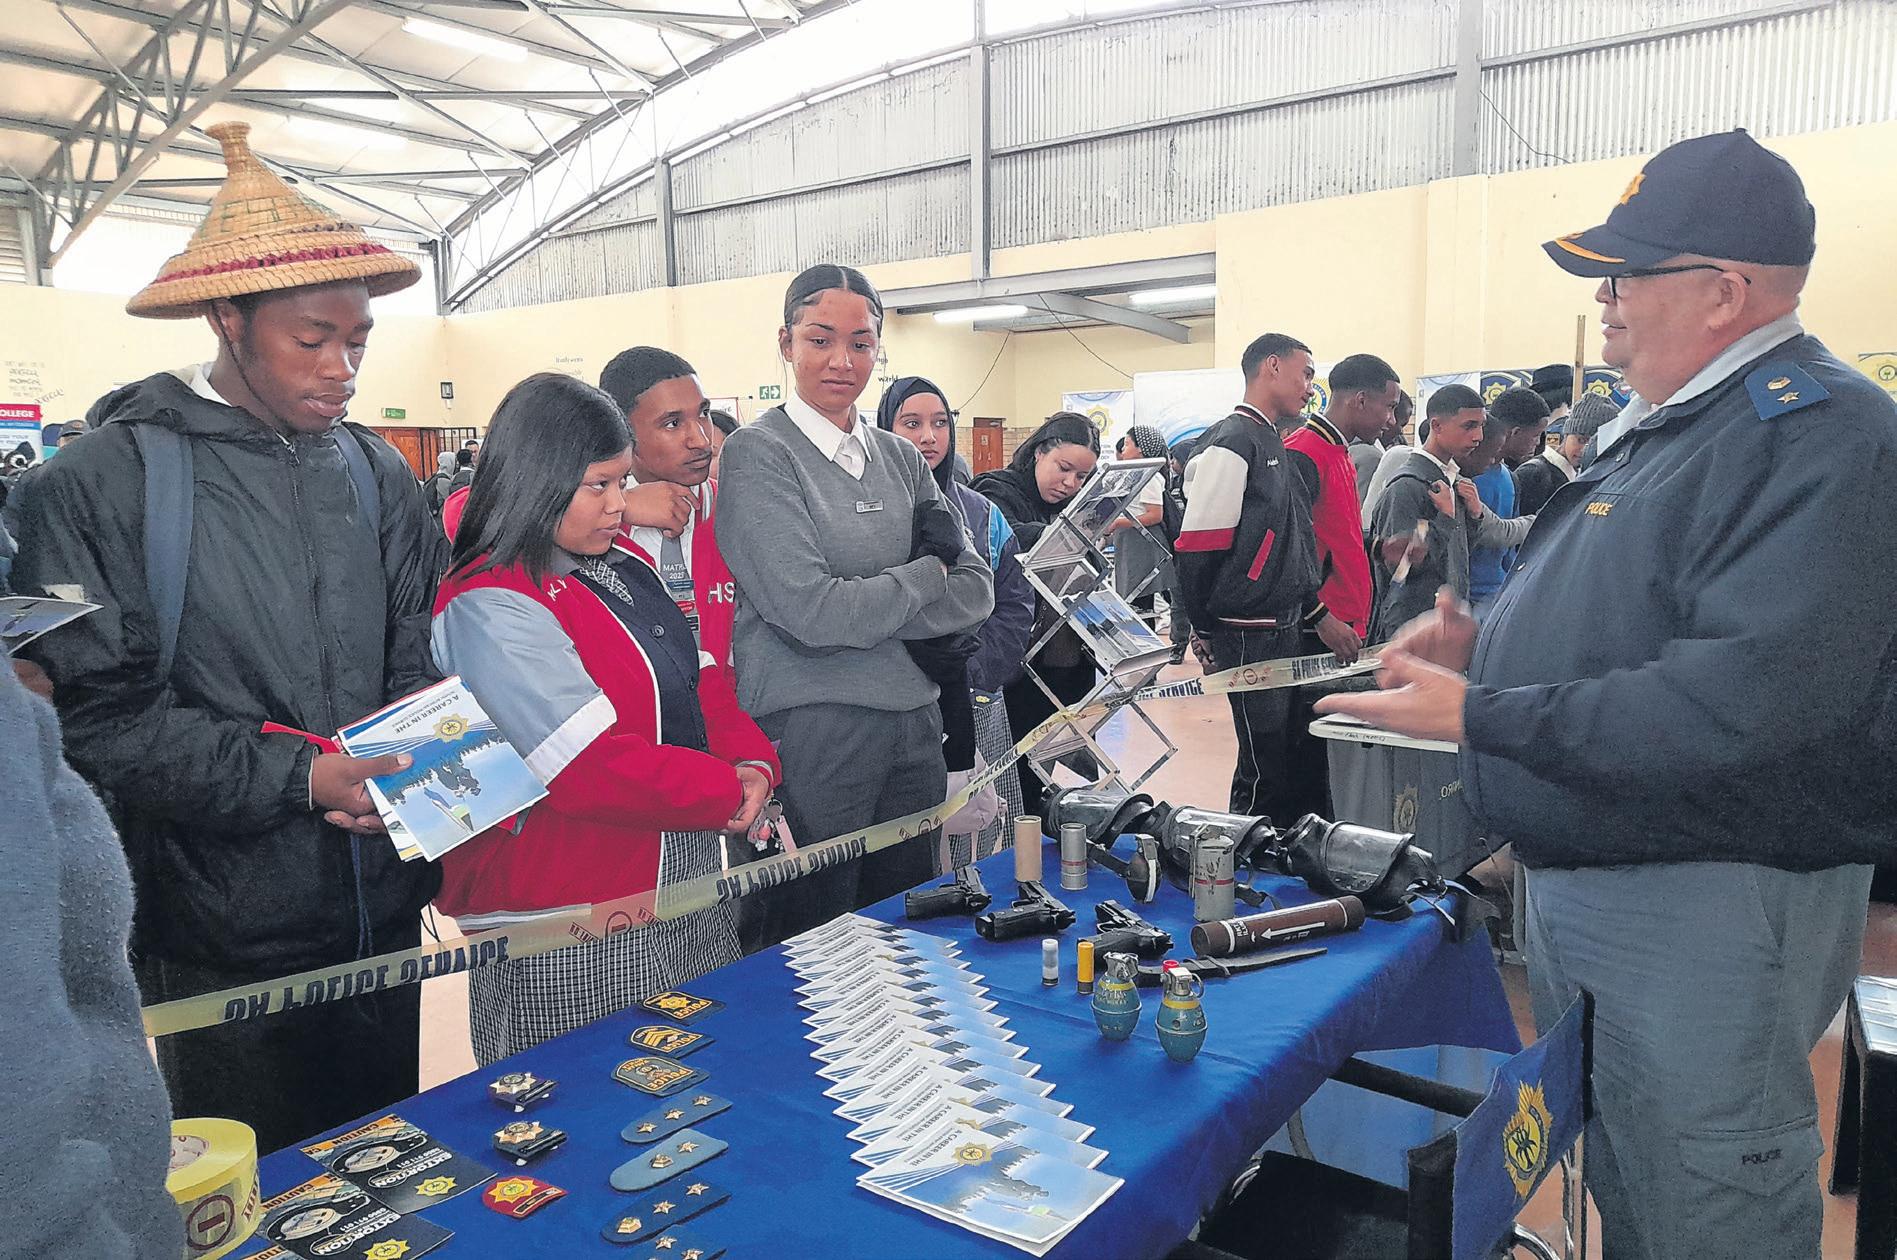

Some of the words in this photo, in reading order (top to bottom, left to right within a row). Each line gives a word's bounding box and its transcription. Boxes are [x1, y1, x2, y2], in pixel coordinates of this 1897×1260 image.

[1584, 501, 1613, 516] POLICE
[421, 698, 453, 719] CAREER
[395, 721, 413, 734] THE
[673, 1000, 708, 1017] POLICE
[647, 1069, 688, 1089] POLICE
[921, 1110, 947, 1129] CAREER
[332, 1123, 379, 1145] CAUTION
[931, 1134, 957, 1152] CAREER
[1742, 1148, 1782, 1165] POLICE
[374, 1152, 452, 1188] EXTORTION
[262, 1183, 314, 1210] CAUTION
[317, 1212, 401, 1255] EXTORTION
